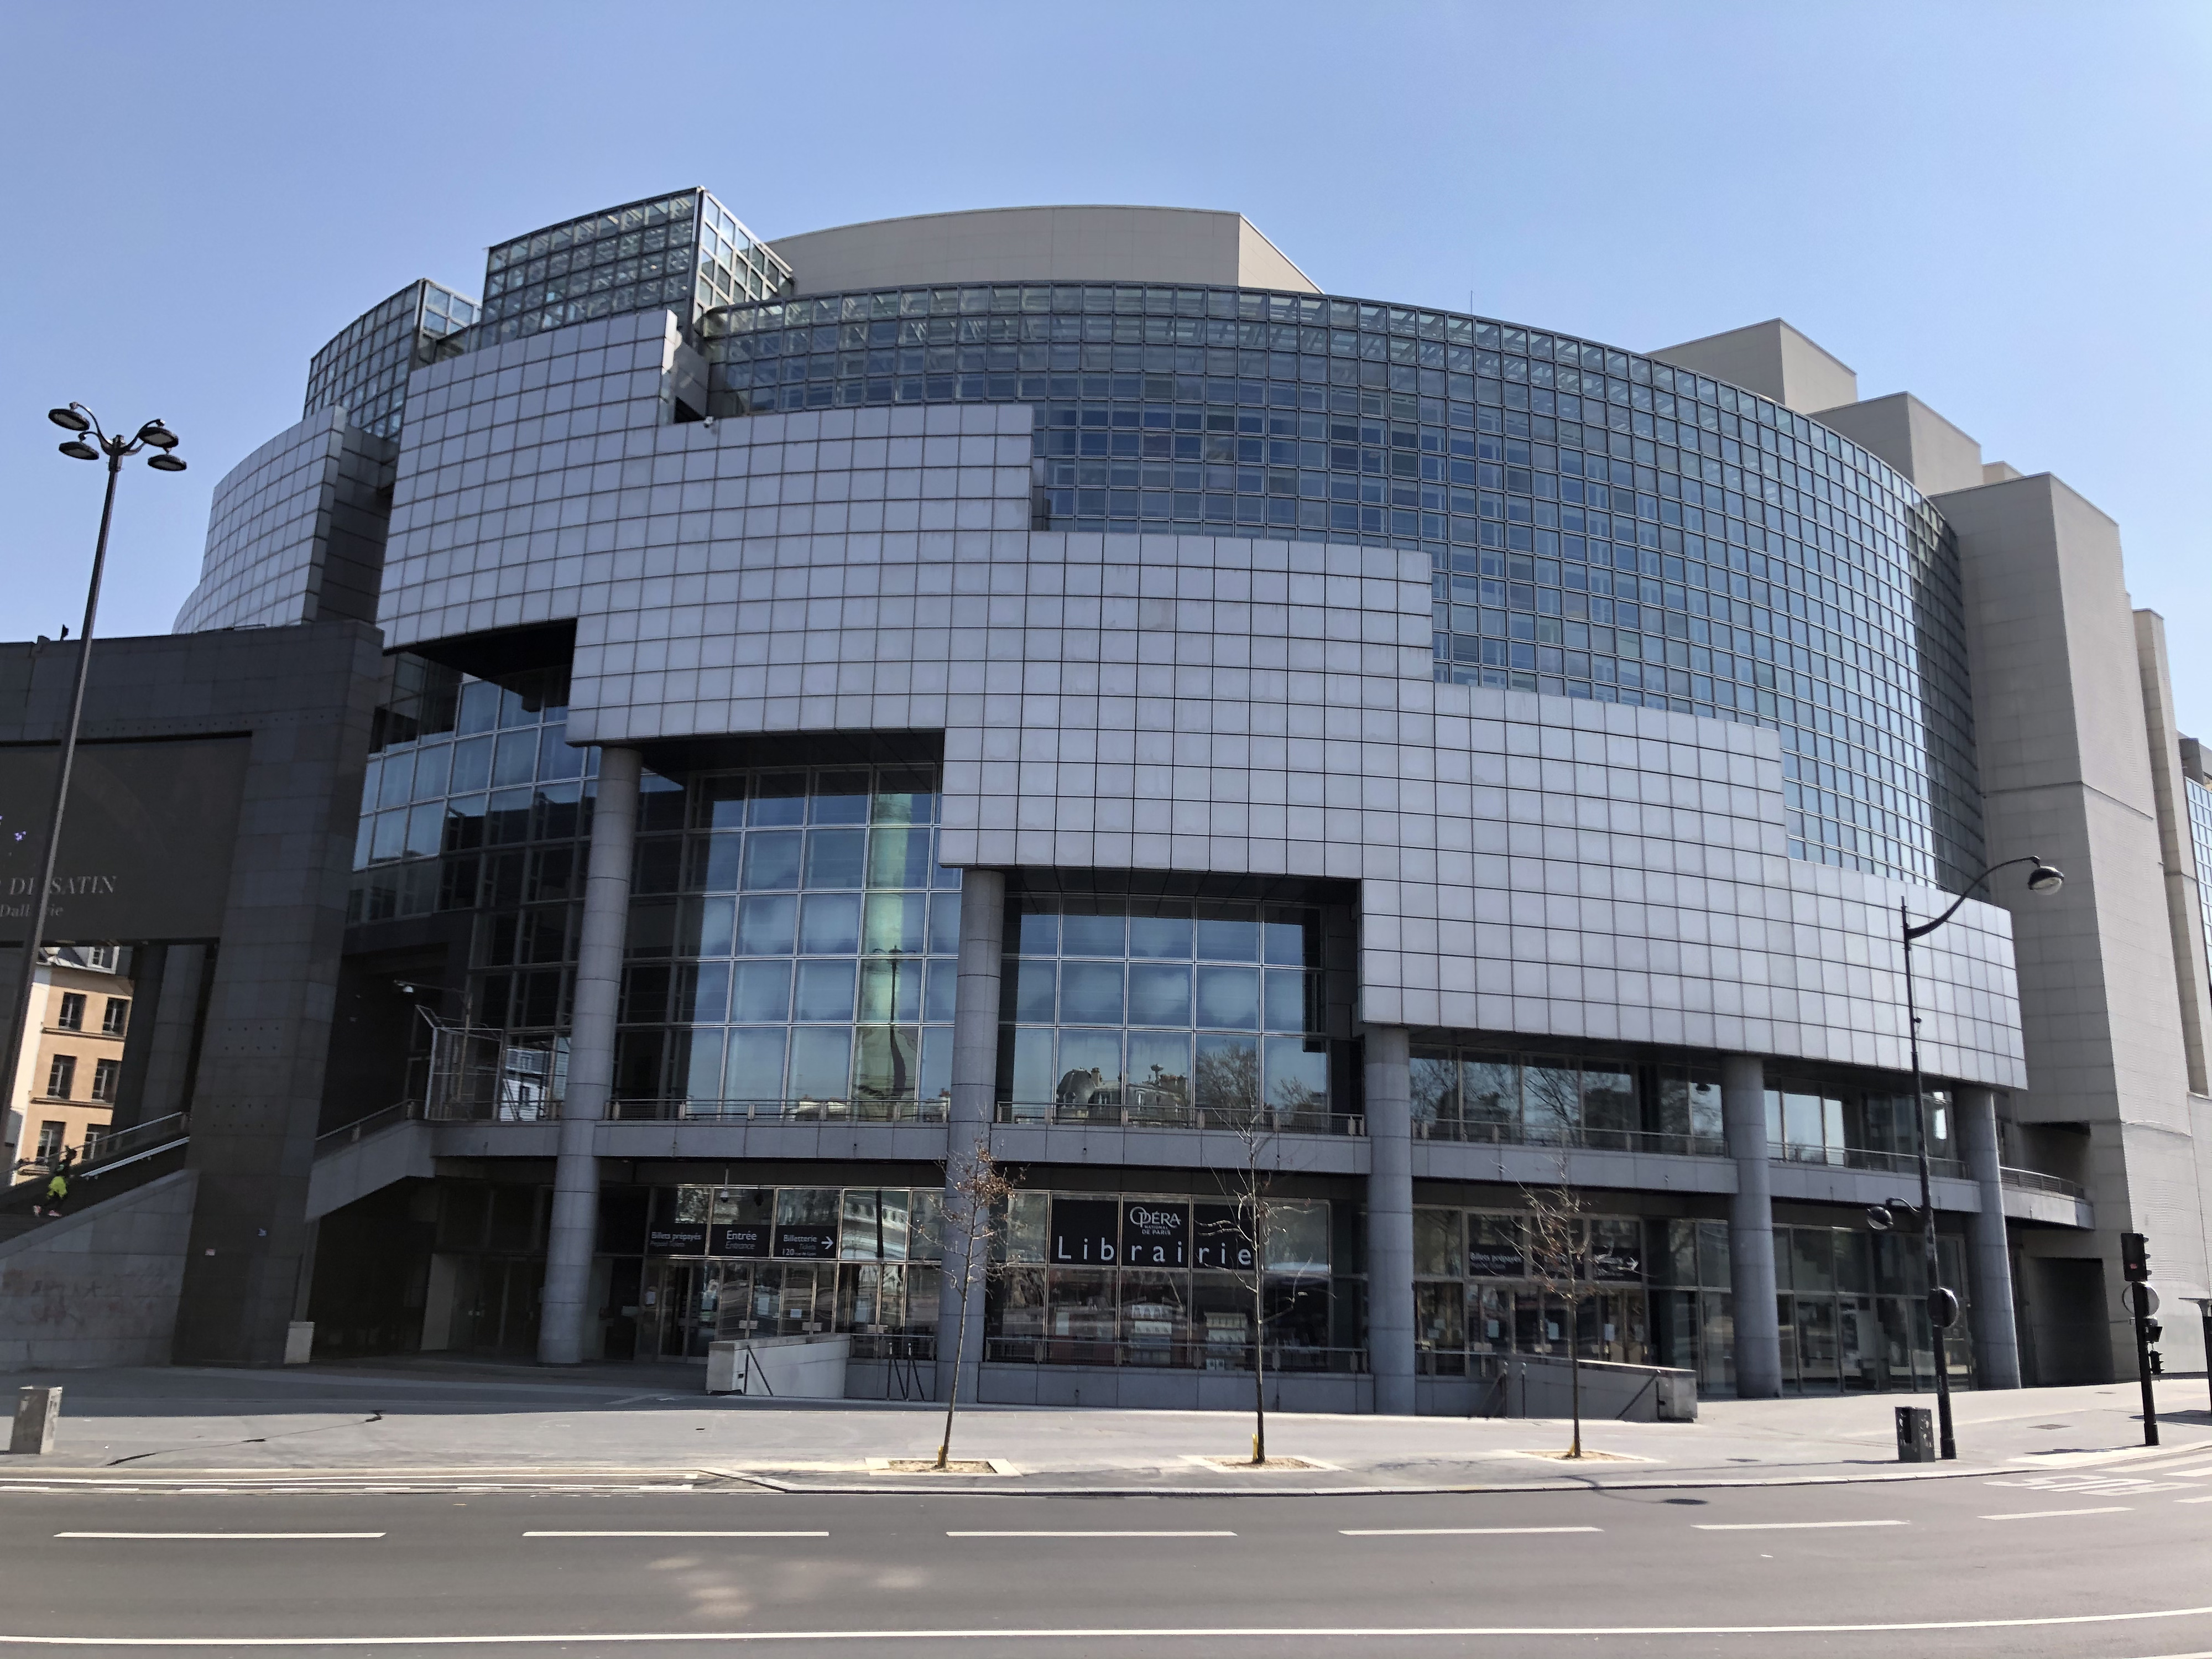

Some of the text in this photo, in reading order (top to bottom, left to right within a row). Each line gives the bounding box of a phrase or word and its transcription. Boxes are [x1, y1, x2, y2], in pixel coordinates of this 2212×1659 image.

[49, 875, 117, 895] SATIN
[726, 1229, 758, 1241] Entrée
[783, 1234, 817, 1243] Billetterie
[782, 1248, 794, 1256] 120
[1058, 1235, 1251, 1265] Librairie
